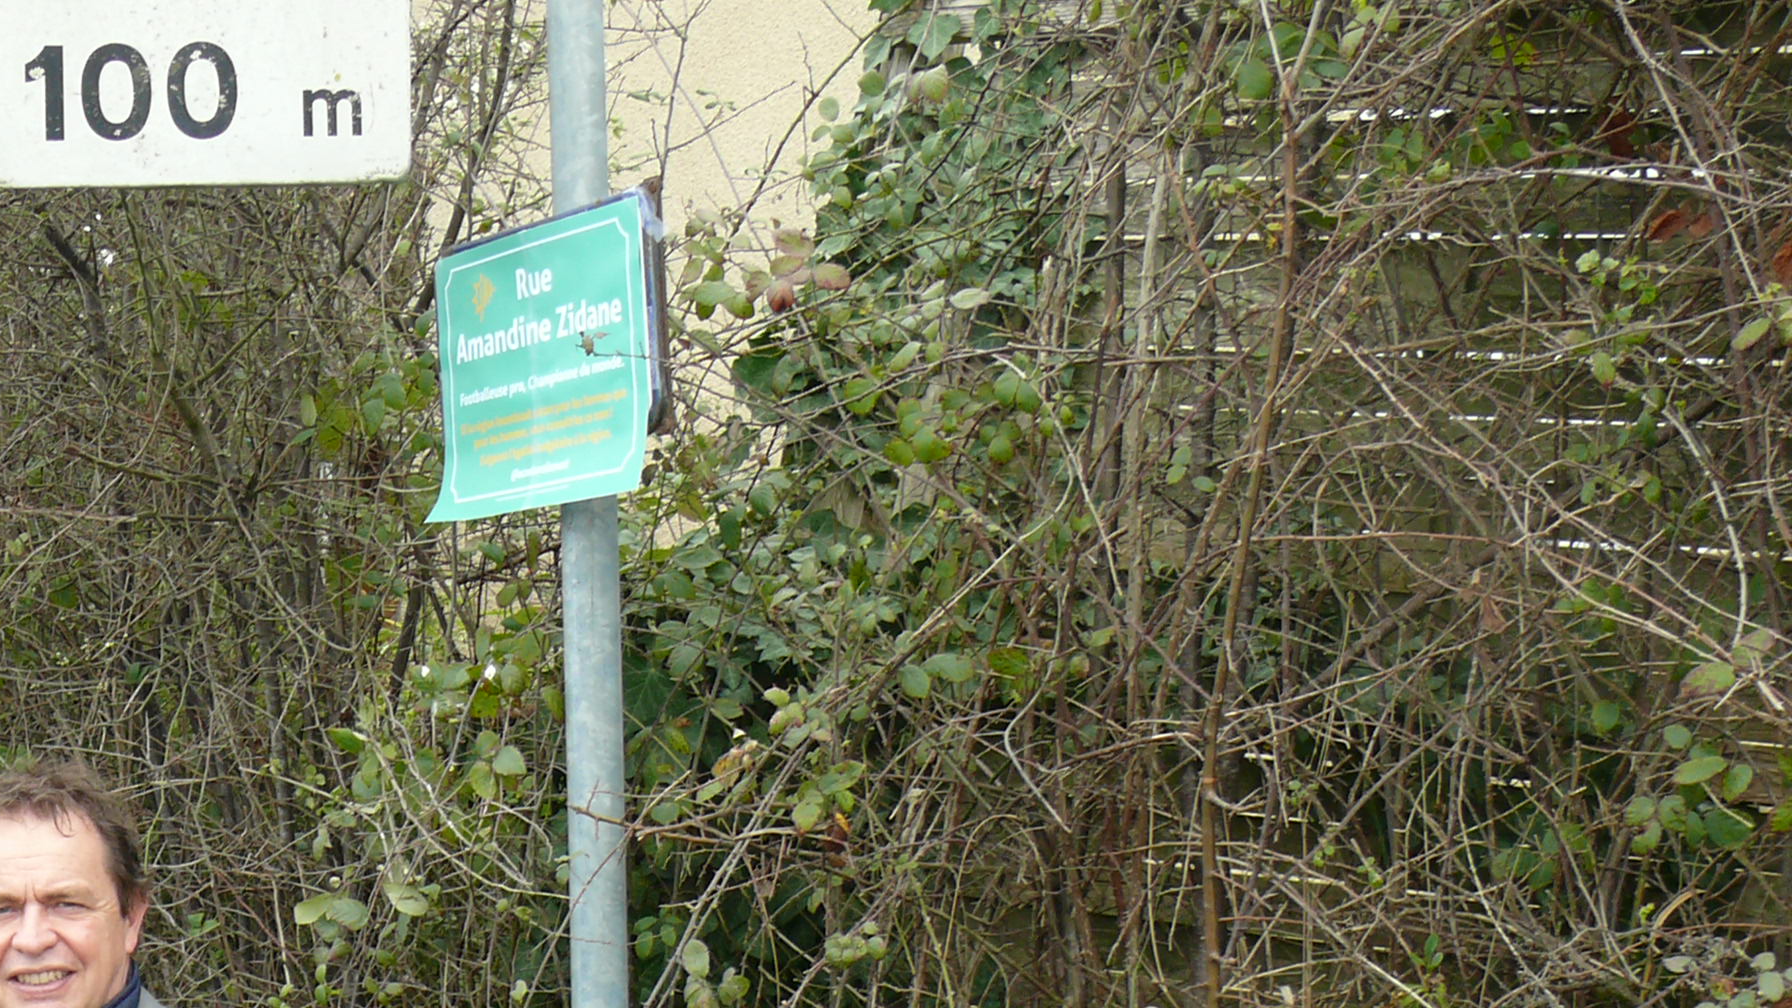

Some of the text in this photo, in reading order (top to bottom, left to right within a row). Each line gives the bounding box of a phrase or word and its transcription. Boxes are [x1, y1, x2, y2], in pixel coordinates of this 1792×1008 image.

[24, 41, 363, 141] 100 m
[515, 268, 553, 300] Rue
[456, 297, 623, 365] Amandine Zidane
